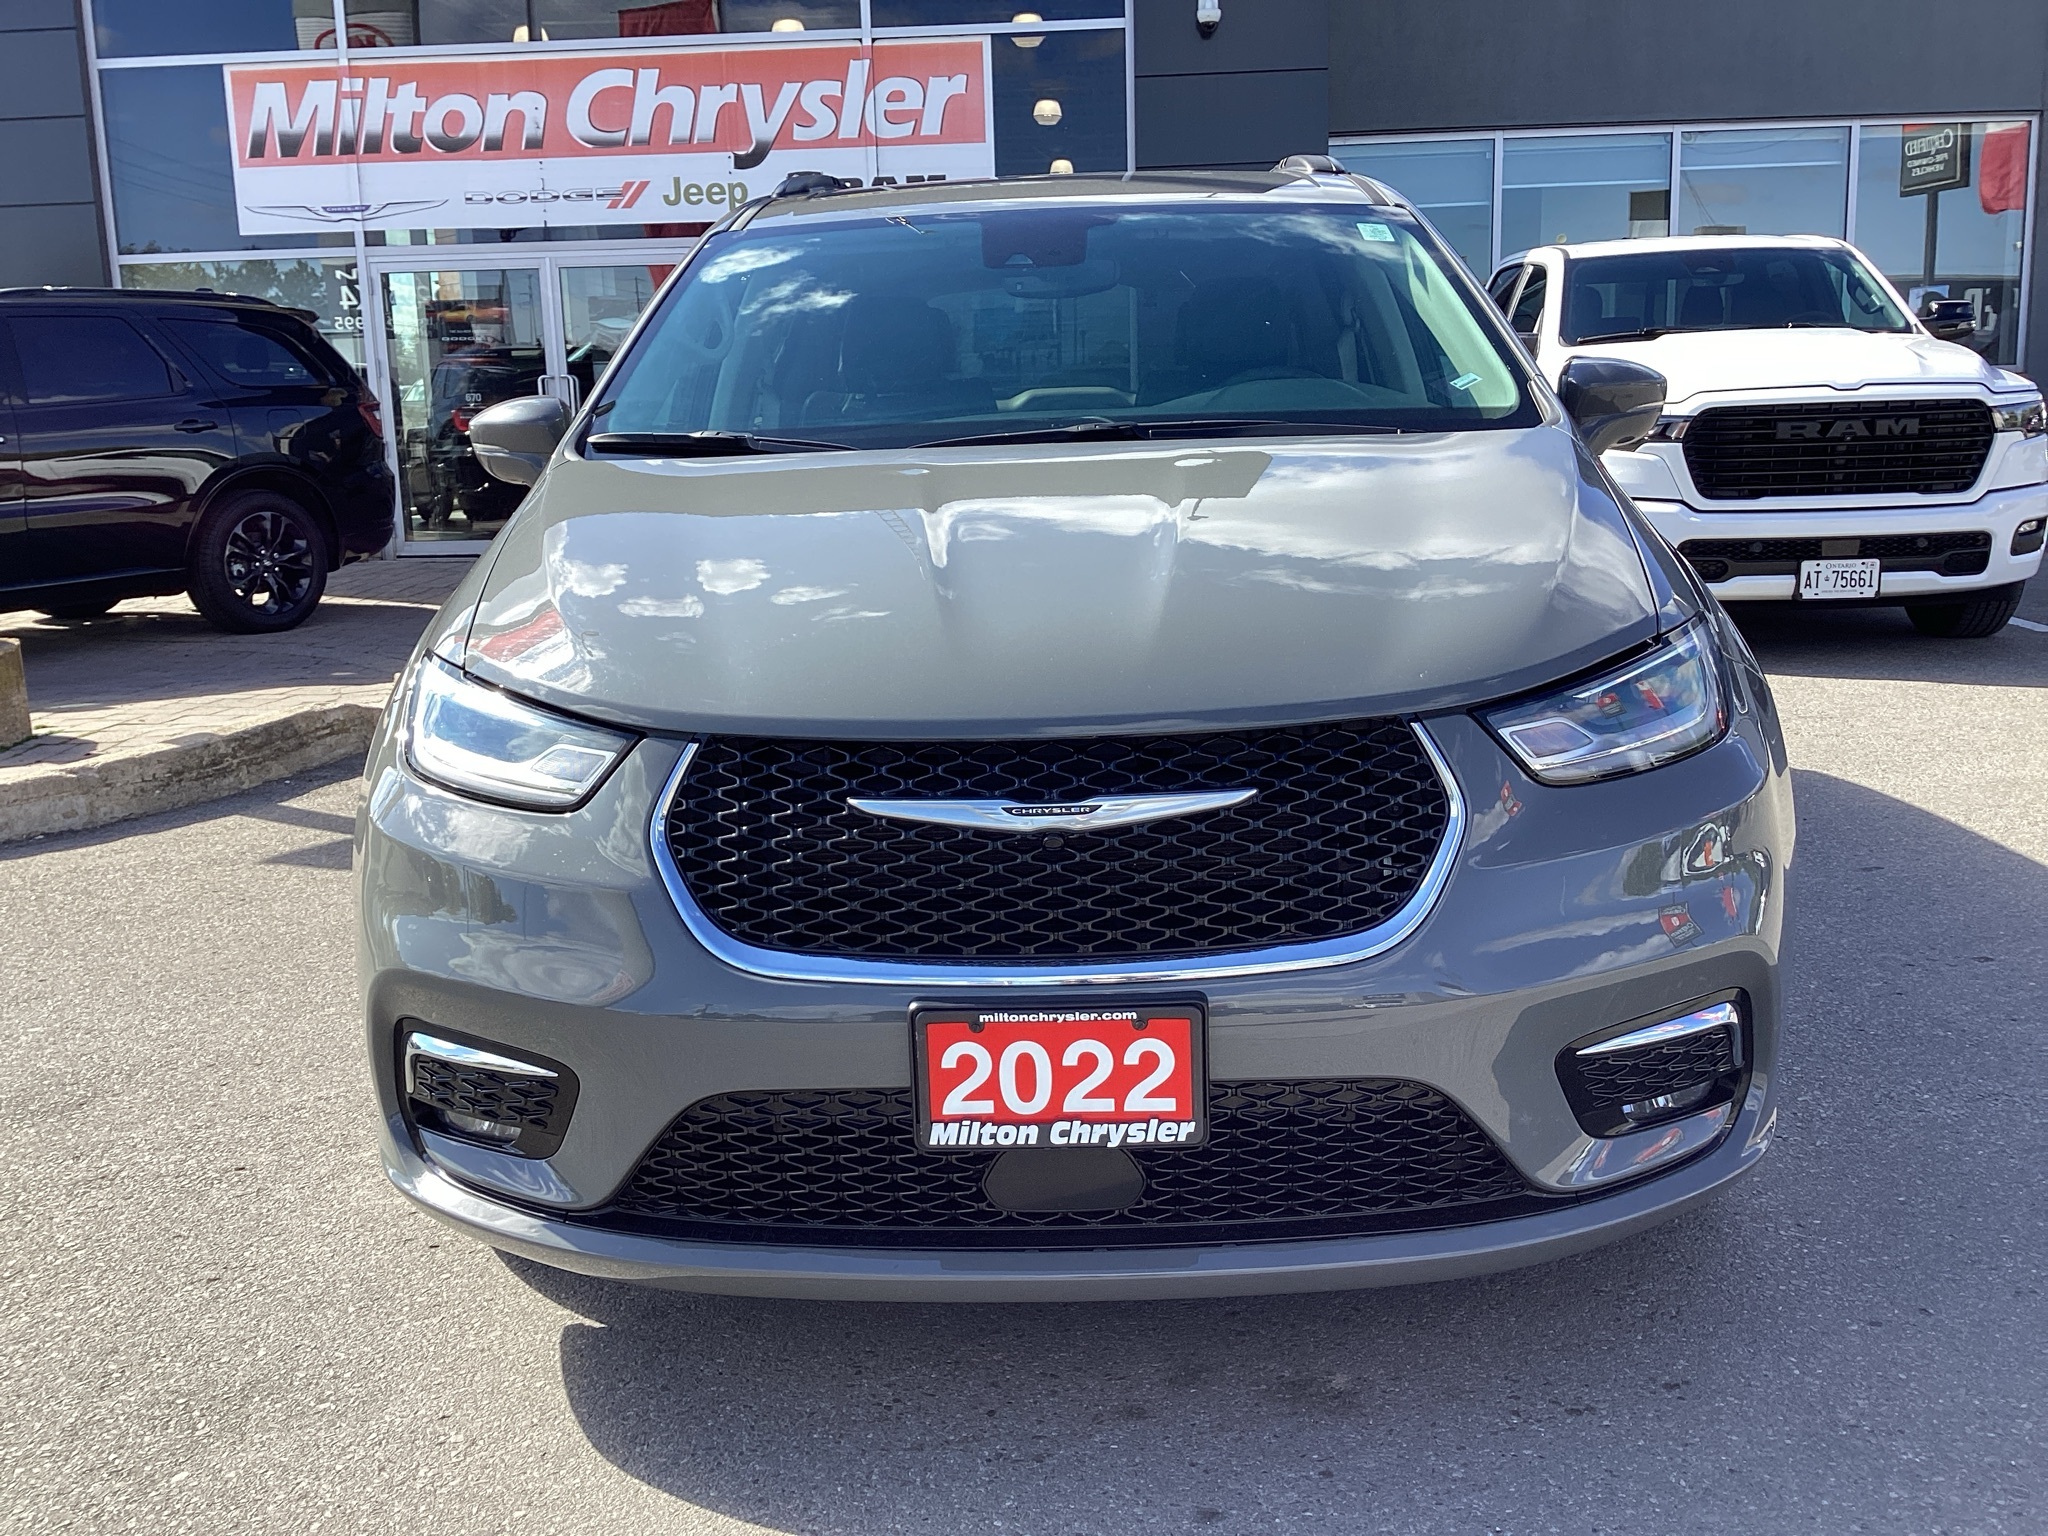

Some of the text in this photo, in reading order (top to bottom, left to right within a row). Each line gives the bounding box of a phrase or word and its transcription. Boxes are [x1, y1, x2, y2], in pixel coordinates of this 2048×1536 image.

[247, 58, 968, 170] Milton Chrysler
[464, 187, 625, 205] DODGE
[662, 176, 748, 210] Jeep
[1775, 418, 1920, 440] RAM
[1825, 562, 1857, 570] ONTARIO
[1804, 569, 1874, 589] AT 75661
[1011, 806, 1090, 815] CHRYSLER
[979, 1010, 1138, 1024] miltonchrysler.com
[940, 1037, 1177, 1116] 2022
[929, 1118, 1196, 1148] Milton Chrysler
